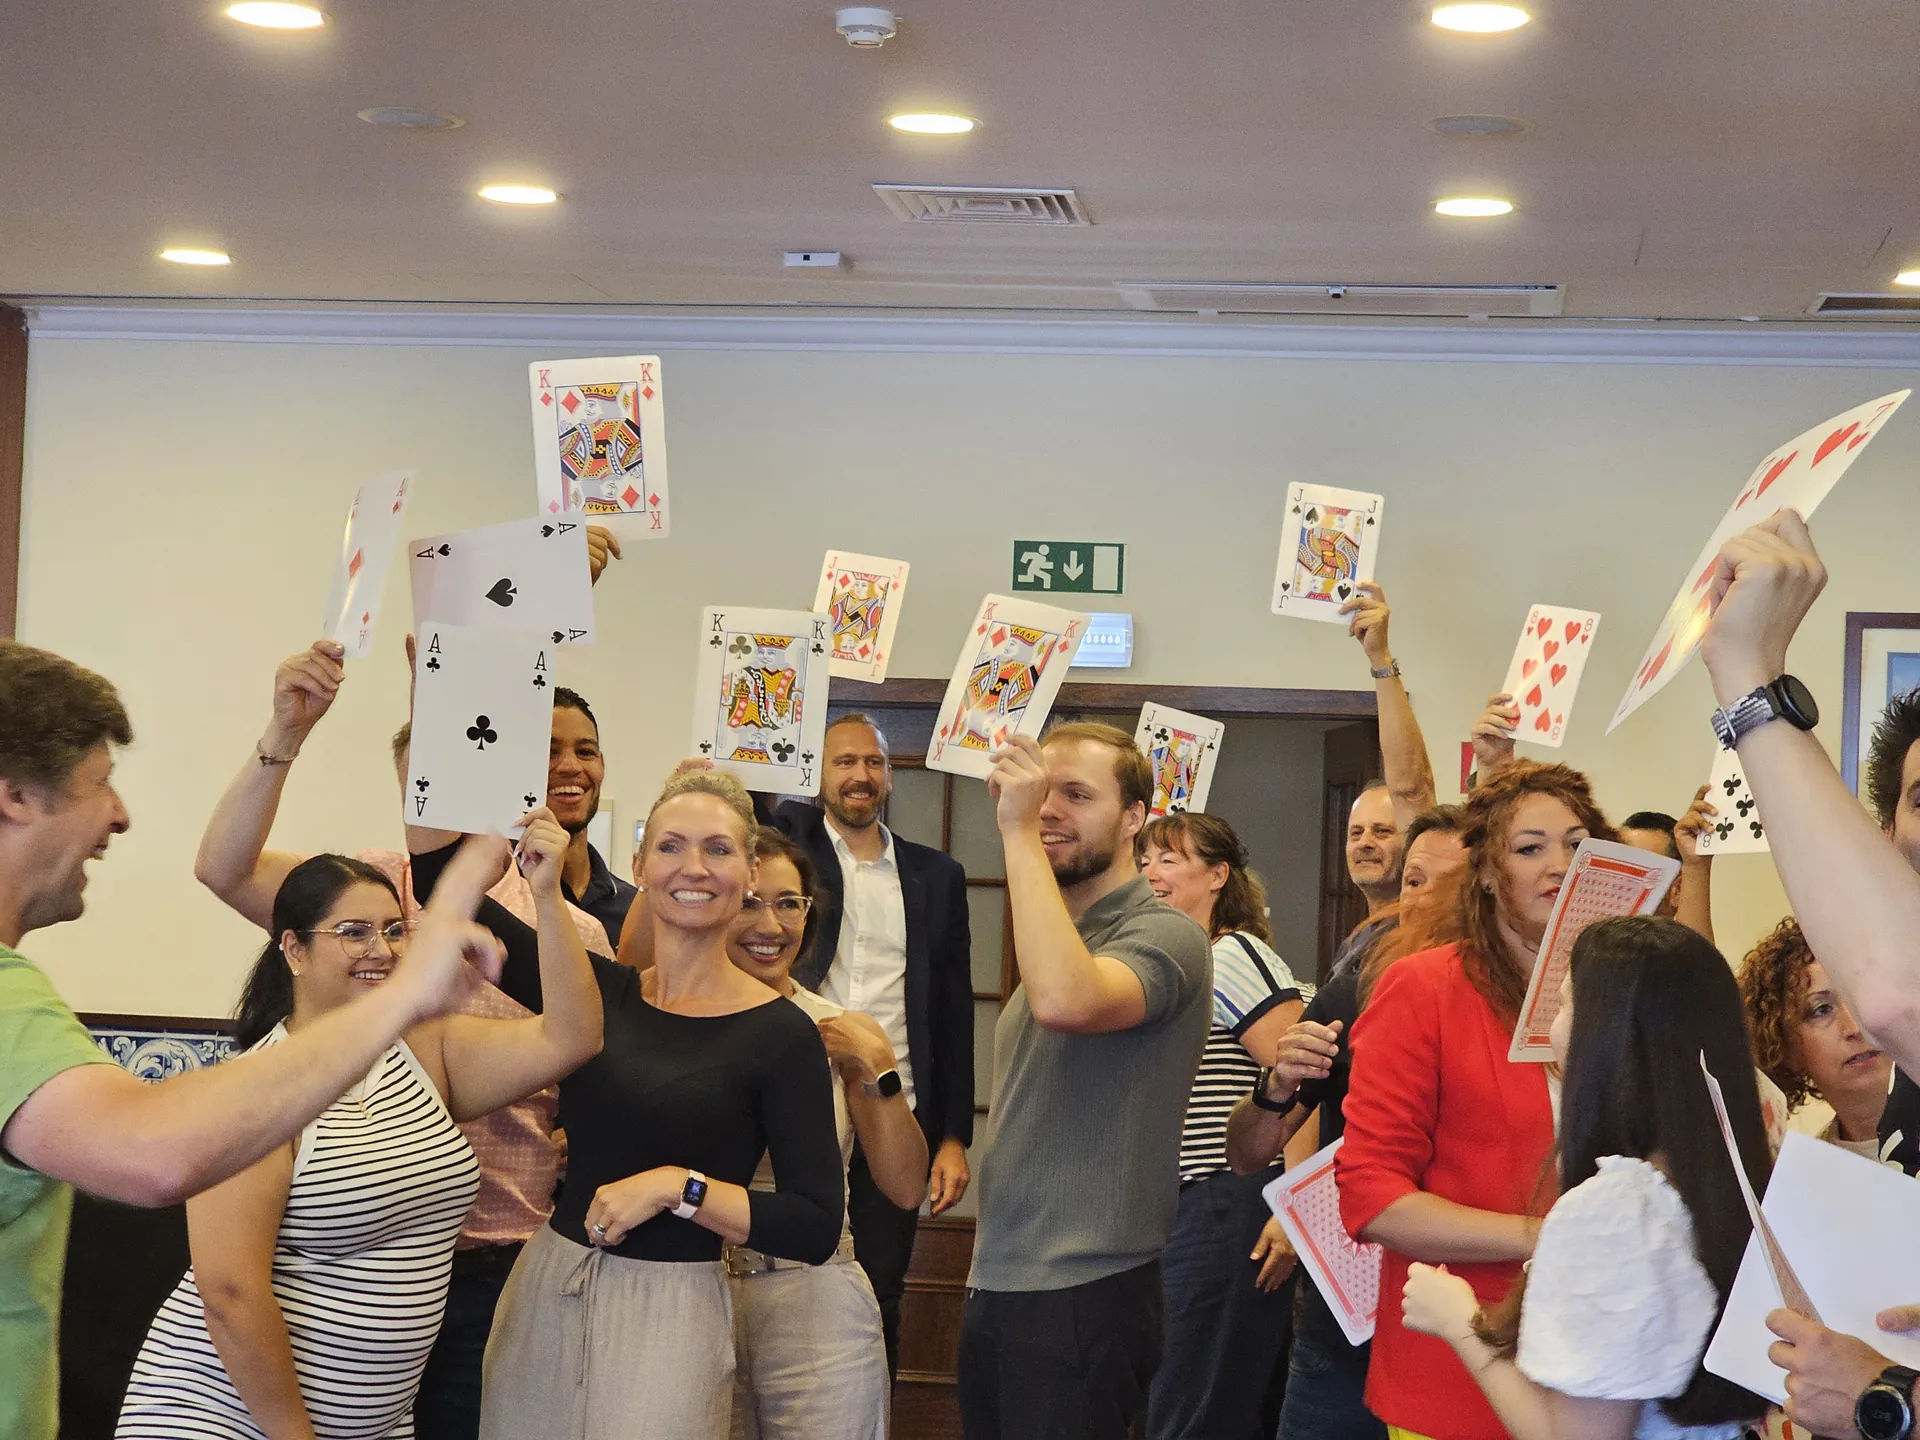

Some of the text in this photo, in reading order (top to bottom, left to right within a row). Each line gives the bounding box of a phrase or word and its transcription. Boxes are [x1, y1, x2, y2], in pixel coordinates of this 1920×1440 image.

[537, 369, 552, 388] K
[640, 363, 654, 382] K
[1294, 488, 1304, 502] J
[1368, 500, 1379, 514] J
[650, 511, 662, 530] K
[559, 522, 577, 535] A
[416, 547, 434, 560] A
[829, 556, 838, 569] J
[893, 565, 905, 579] J
[1278, 594, 1289, 609] J
[982, 602, 999, 620] K
[1530, 611, 1539, 624] 8
[712, 613, 724, 632] K
[812, 621, 826, 639] K
[1064, 620, 1082, 638] K
[1584, 618, 1593, 632] 8
[569, 628, 588, 642] A
[428, 633, 441, 654] A
[534, 650, 547, 671] A
[871, 664, 881, 677] J
[1147, 709, 1157, 722] J
[1209, 727, 1219, 741] J
[1551, 726, 1561, 740] 8
[932, 742, 945, 761] K
[799, 768, 812, 787] K
[415, 796, 428, 817] A
[1702, 833, 1712, 848] 8
